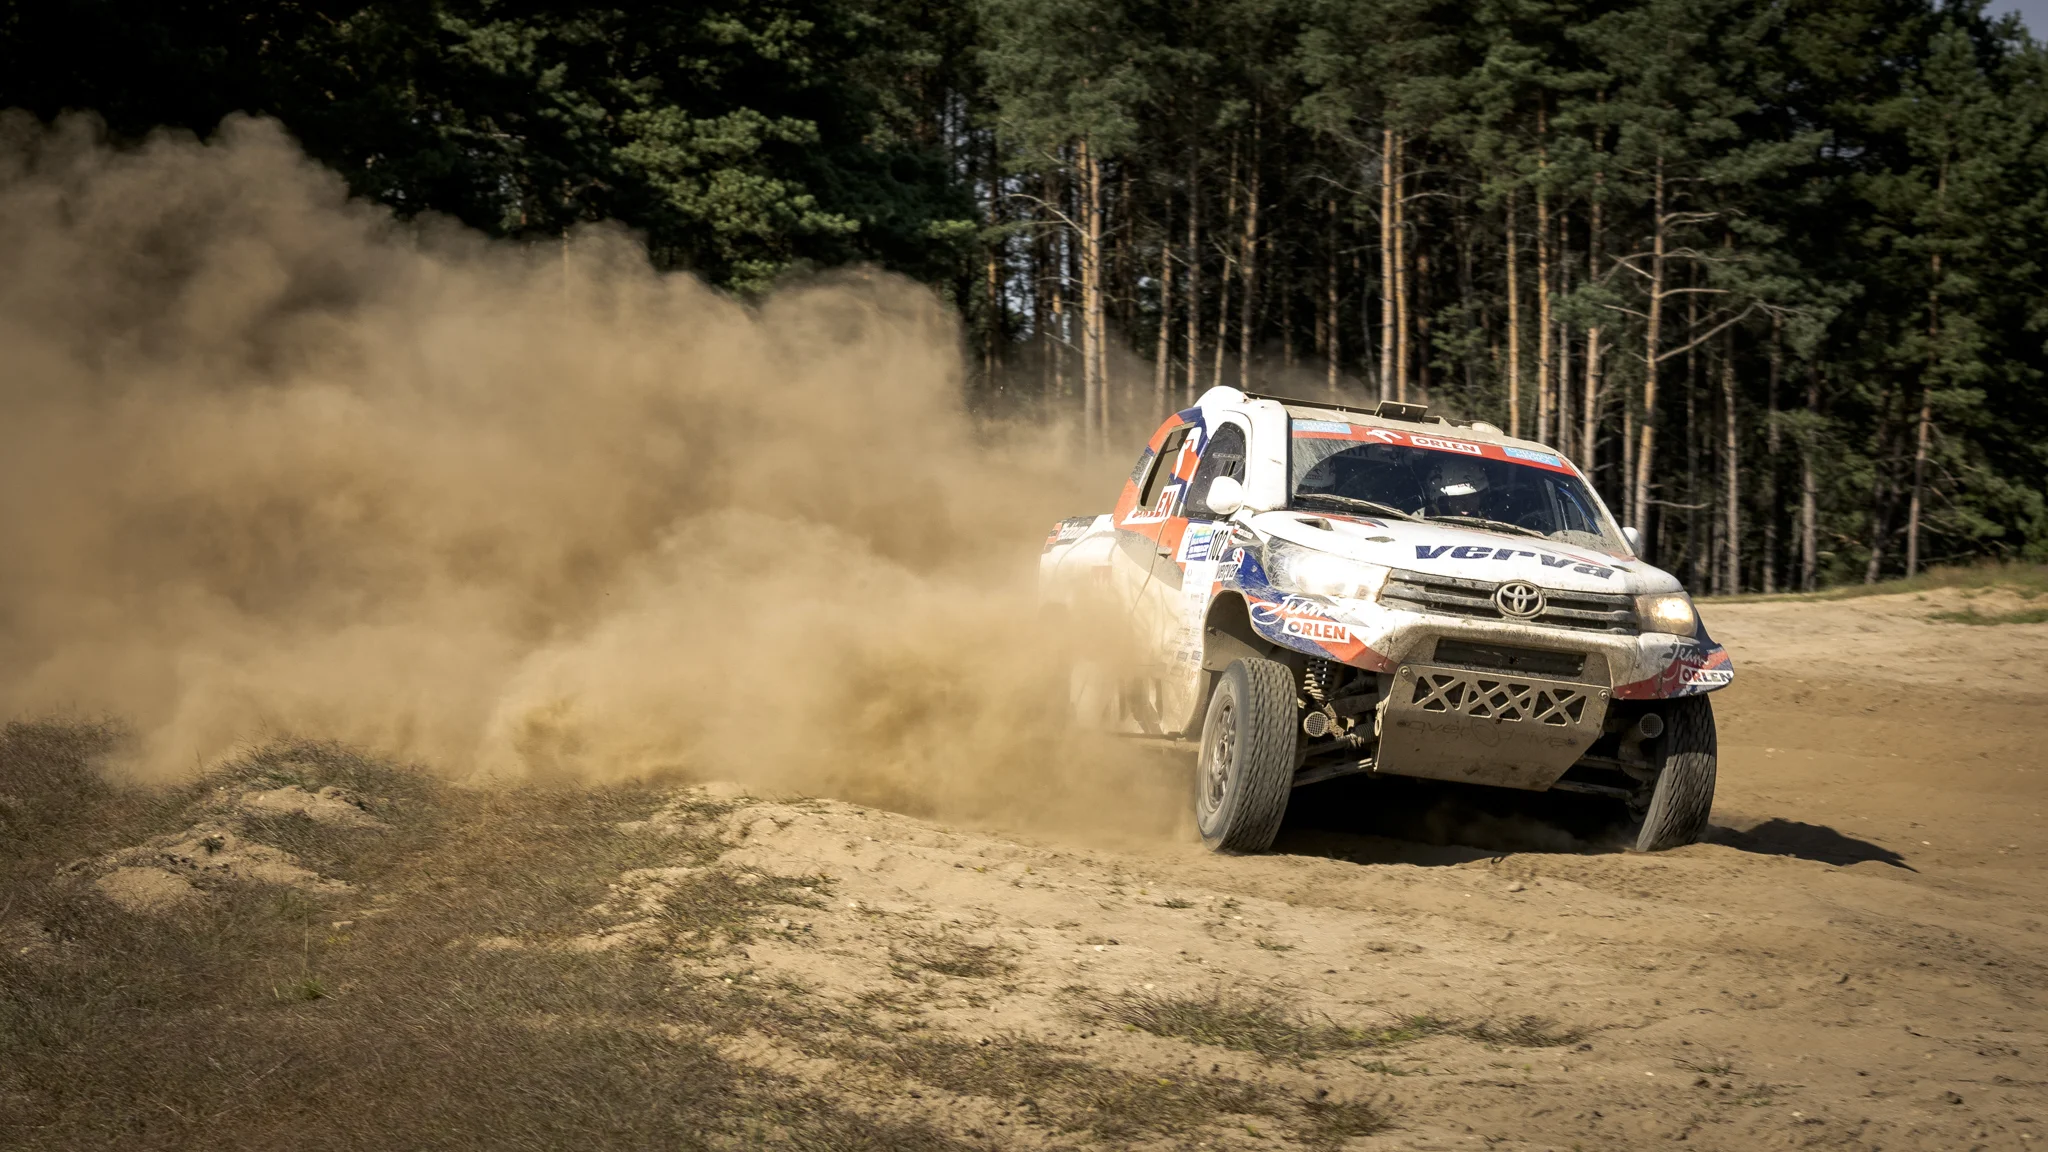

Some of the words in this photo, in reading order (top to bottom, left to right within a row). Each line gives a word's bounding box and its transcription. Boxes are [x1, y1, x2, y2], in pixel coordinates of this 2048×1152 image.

[1415, 438, 1476, 453] ORLEN
[1415, 545, 1615, 580] verva
[1250, 594, 1332, 625] Team
[1287, 620, 1346, 641] ORLEN
[1682, 668, 1732, 683] ORLEN
